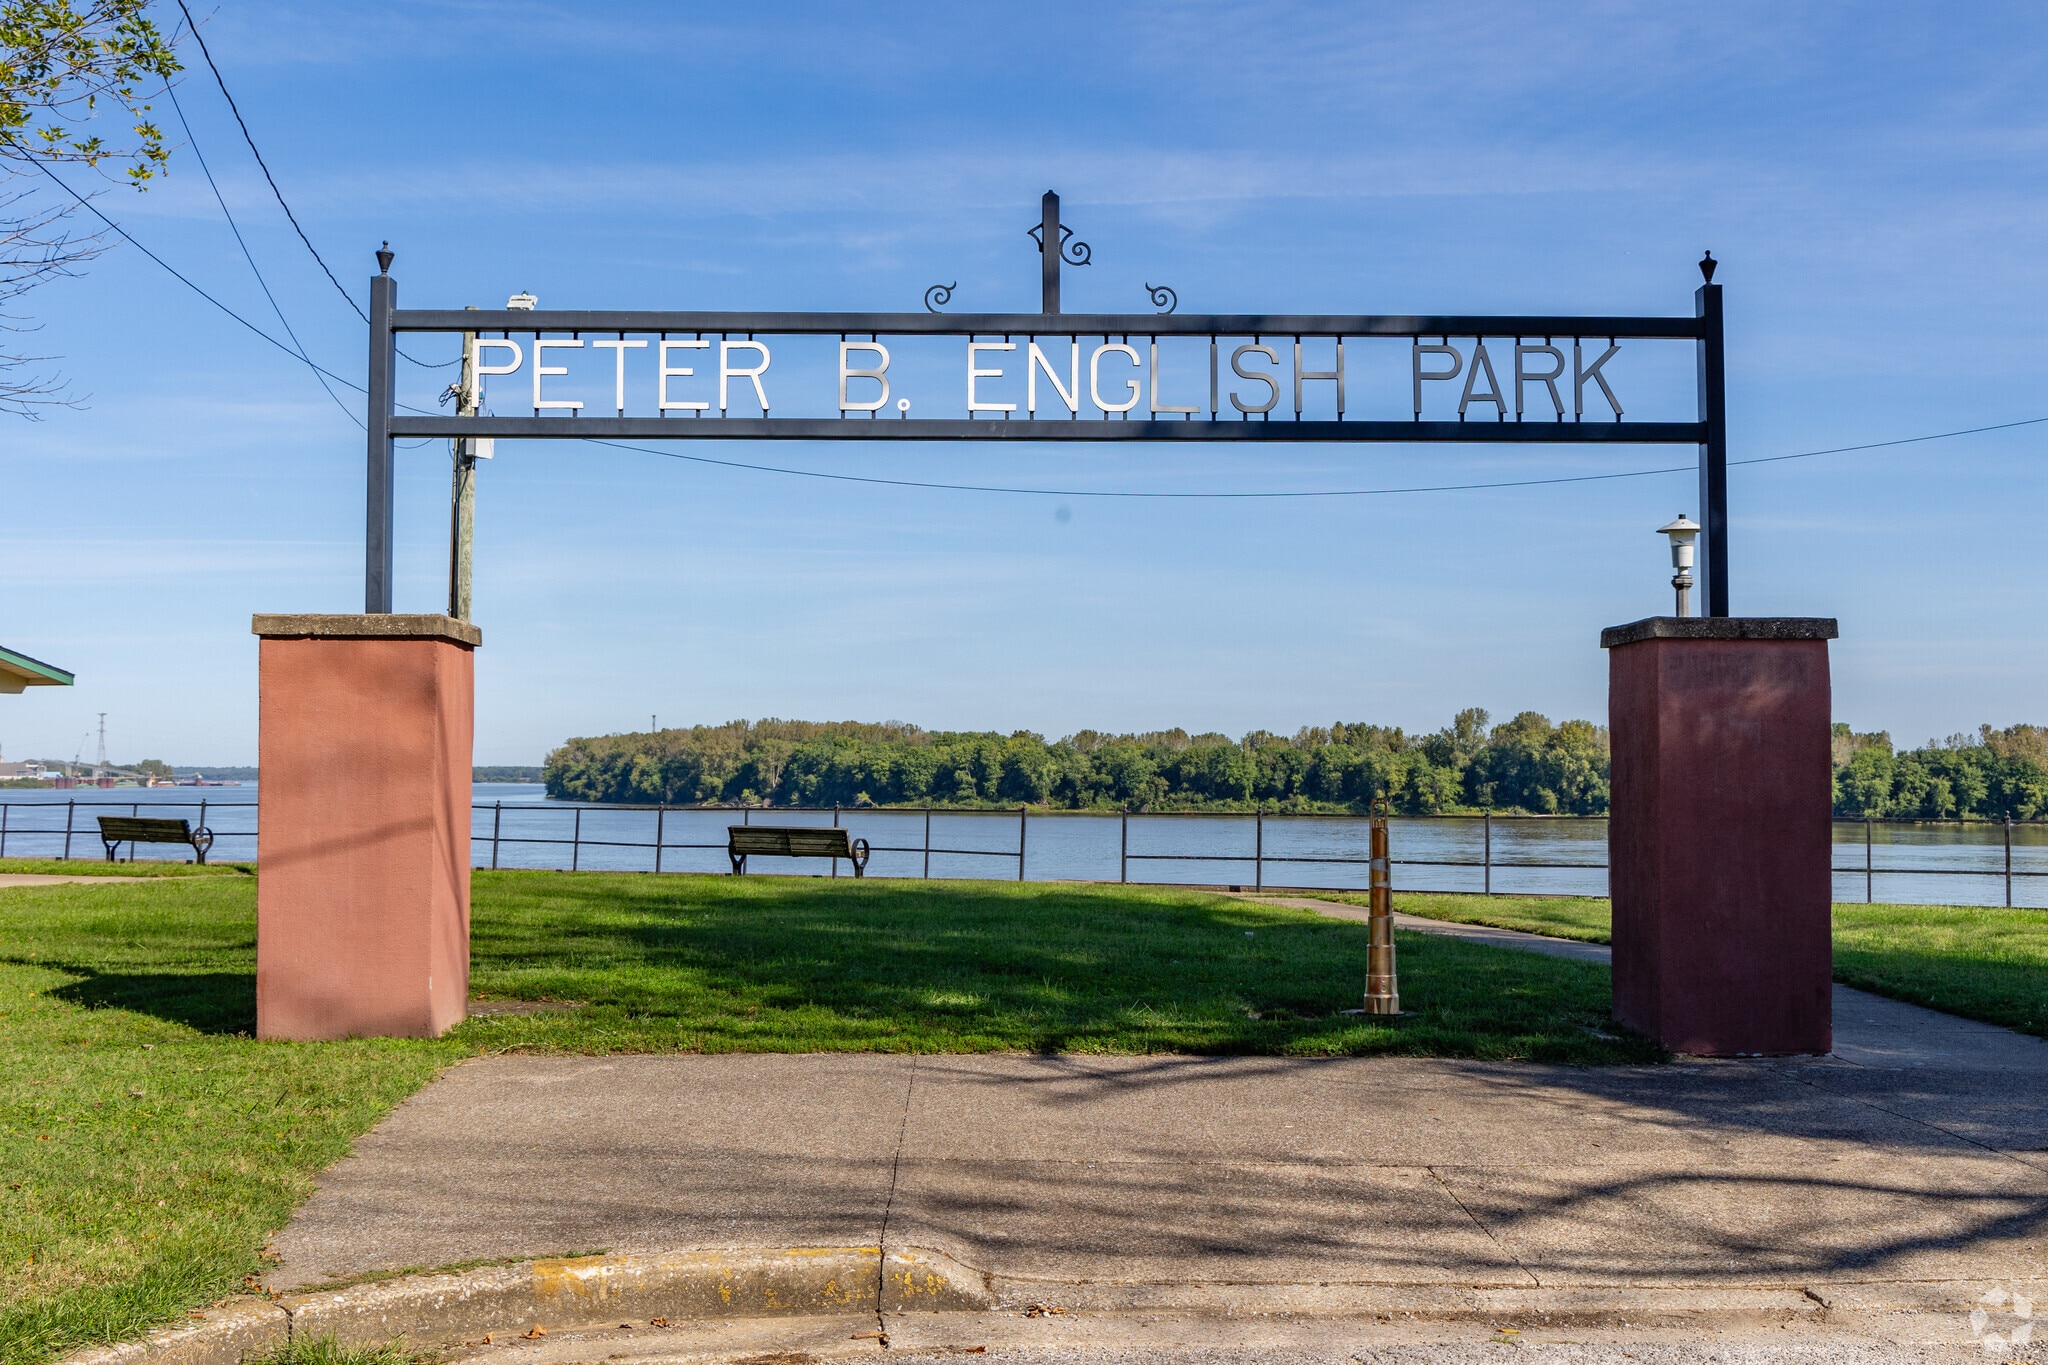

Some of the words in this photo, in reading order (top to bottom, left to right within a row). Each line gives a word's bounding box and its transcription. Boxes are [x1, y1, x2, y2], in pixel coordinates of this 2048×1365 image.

[471, 338, 771, 410] PETER
[839, 341, 911, 412] B.
[967, 342, 1345, 414] ENGLISH
[1413, 344, 1623, 415] PARK
